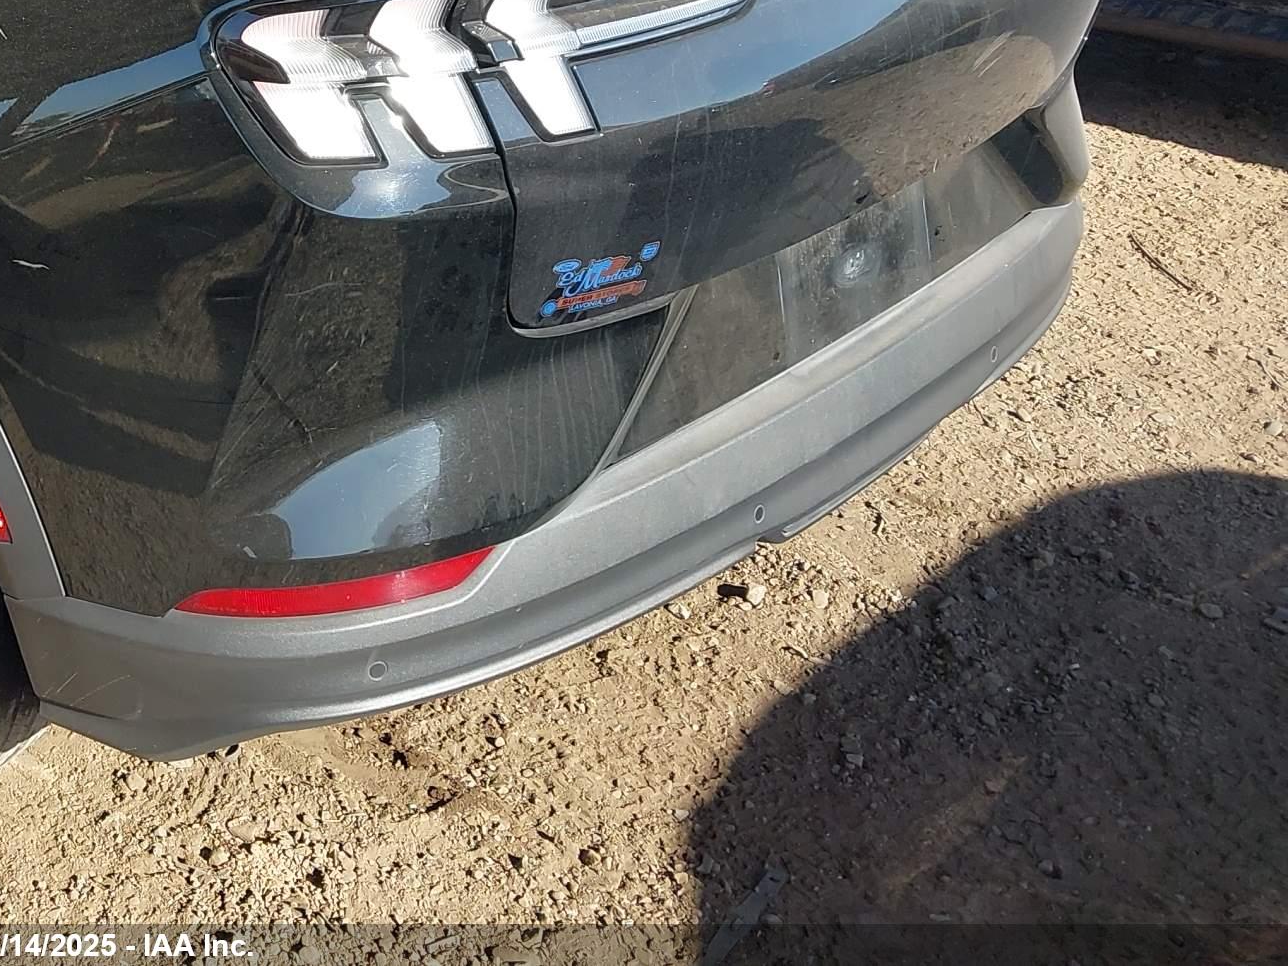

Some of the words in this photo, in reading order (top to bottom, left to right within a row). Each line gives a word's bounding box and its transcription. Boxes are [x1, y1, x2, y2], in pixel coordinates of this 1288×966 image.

[557, 269, 583, 287] Ed
[561, 294, 593, 306] SUPER
[606, 296, 617, 304] GA
